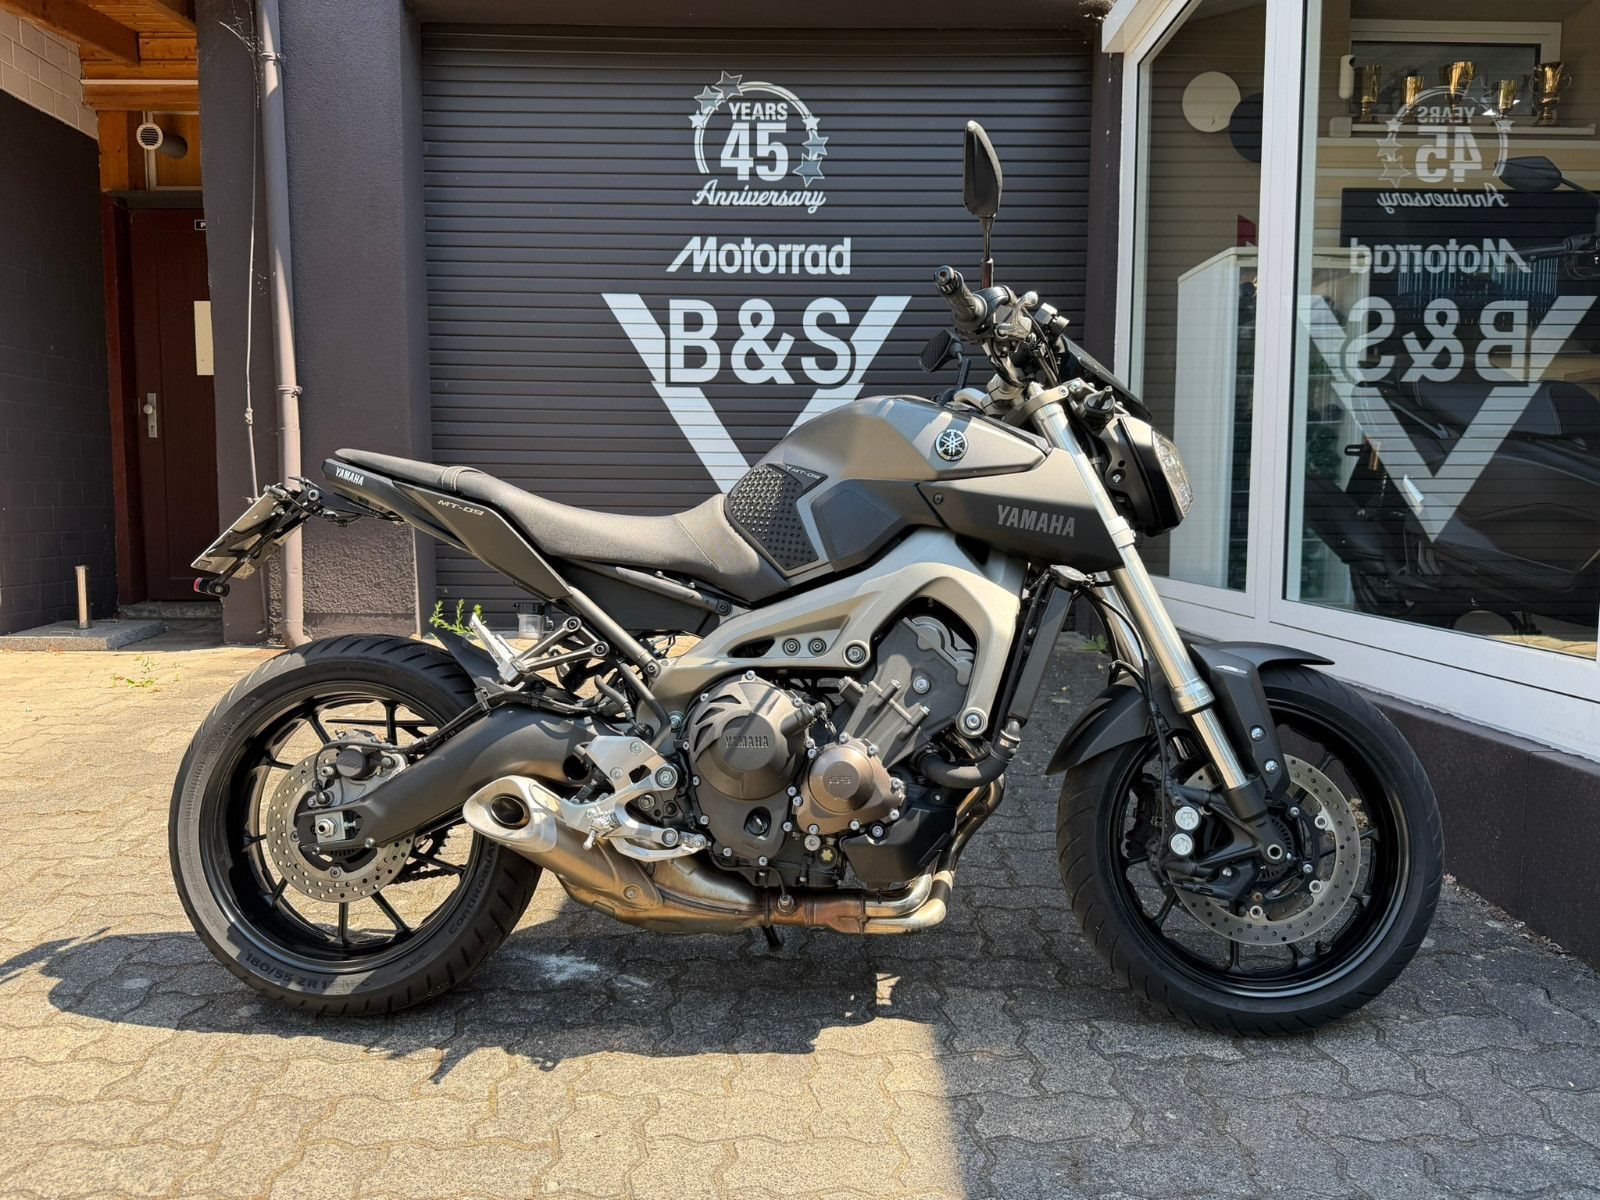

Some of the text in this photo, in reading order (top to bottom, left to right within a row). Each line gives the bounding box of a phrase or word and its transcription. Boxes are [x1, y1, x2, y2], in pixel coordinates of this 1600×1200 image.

[728, 102, 788, 121] YEARS
[720, 122, 789, 181] 45
[692, 179, 827, 214] Anniversary
[666, 236, 851, 275] Motorrad
[669, 297, 852, 385] B&S
[335, 466, 364, 486] YAMAHA
[437, 499, 485, 516] MT-09
[997, 504, 1075, 538] YAMAHA
[725, 735, 769, 748] YAMAHA
